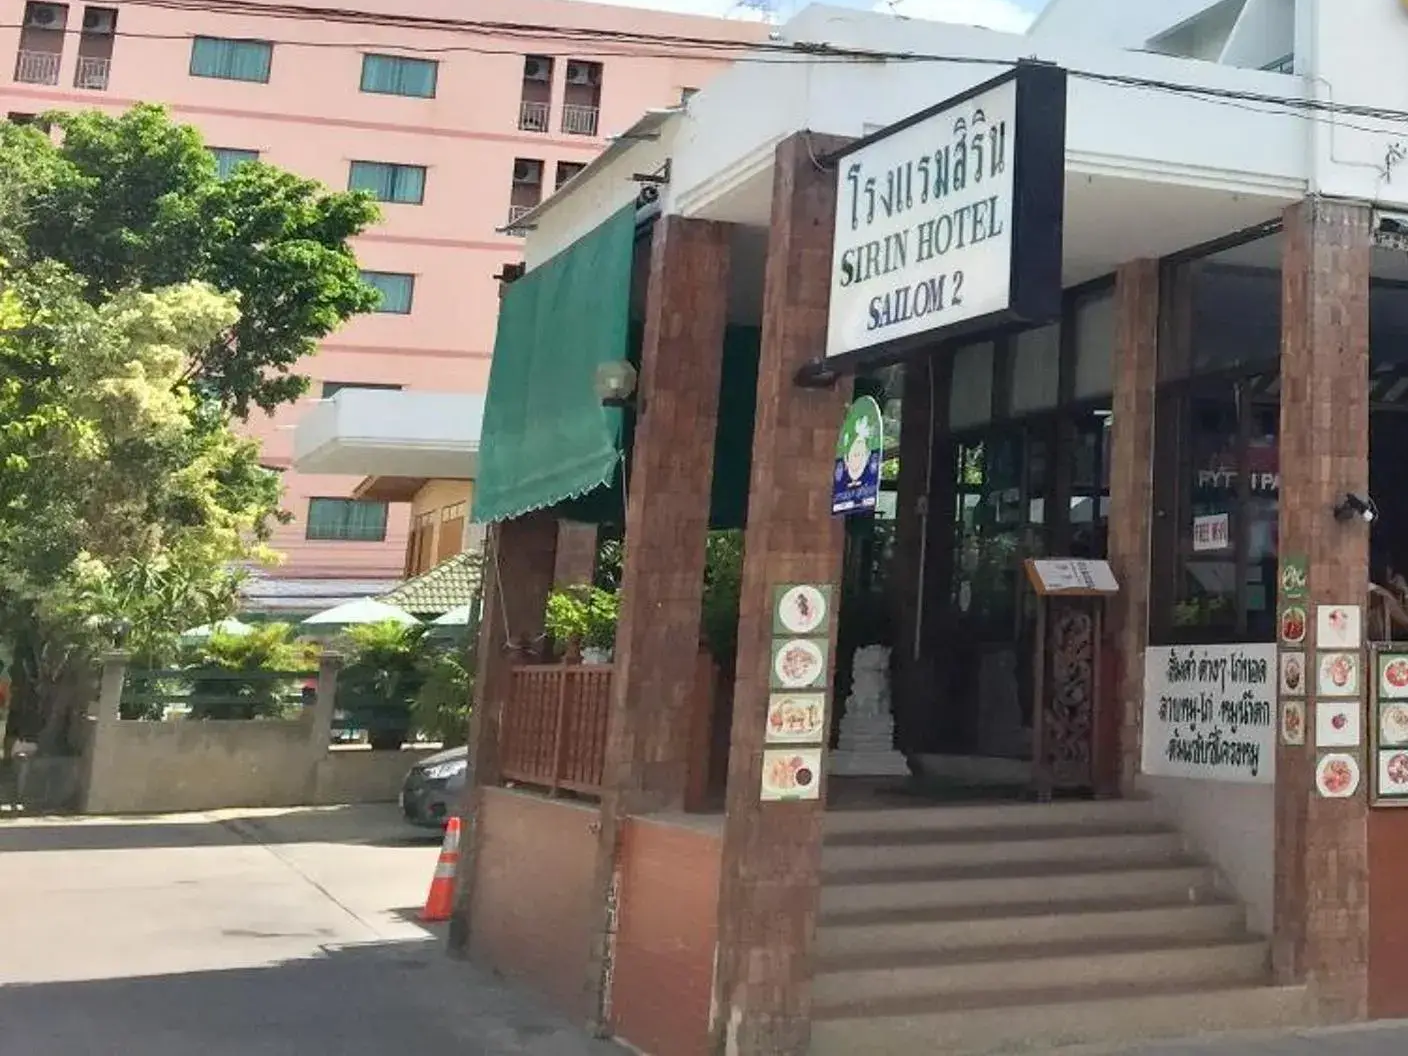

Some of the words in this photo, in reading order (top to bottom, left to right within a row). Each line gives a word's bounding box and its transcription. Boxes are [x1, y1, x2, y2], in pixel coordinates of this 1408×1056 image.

[839, 228, 910, 288] SIRIN
[915, 195, 1004, 264] HOTEL
[866, 273, 945, 331] SAILOM
[950, 270, 965, 307] 2
